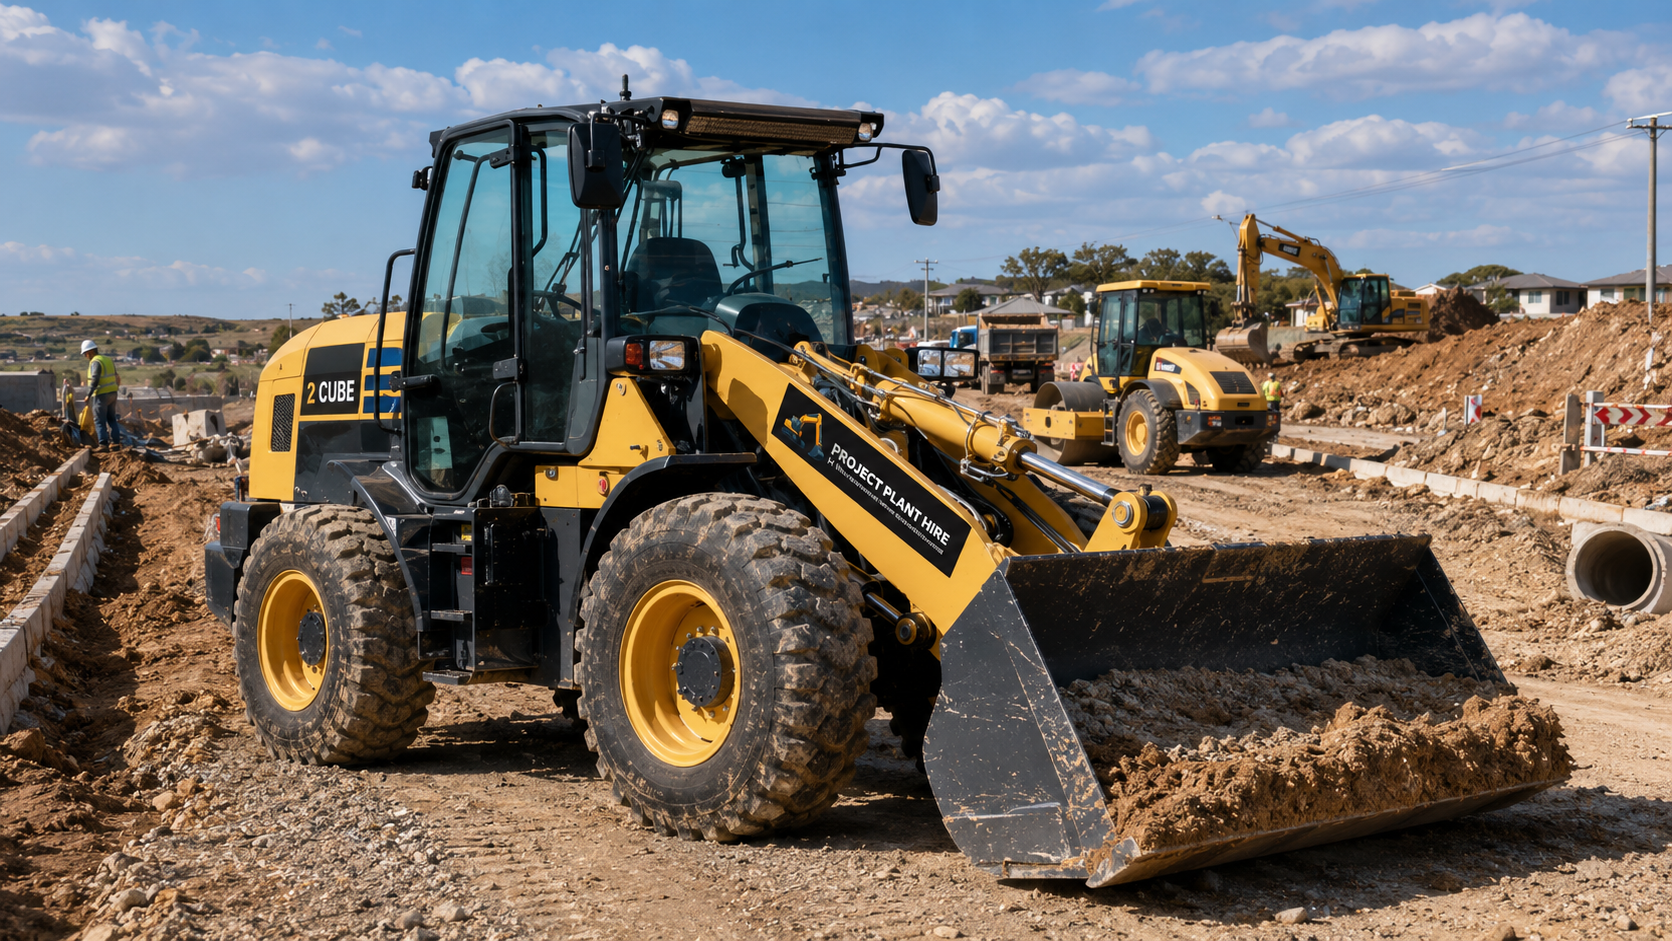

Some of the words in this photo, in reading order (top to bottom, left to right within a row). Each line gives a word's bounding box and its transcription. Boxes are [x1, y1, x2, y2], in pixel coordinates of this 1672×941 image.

[307, 382, 316, 405] 2
[318, 380, 355, 403] CUBE
[831, 443, 884, 491] PROJECT
[882, 485, 922, 522] PLANT
[922, 516, 951, 546] HIRE
